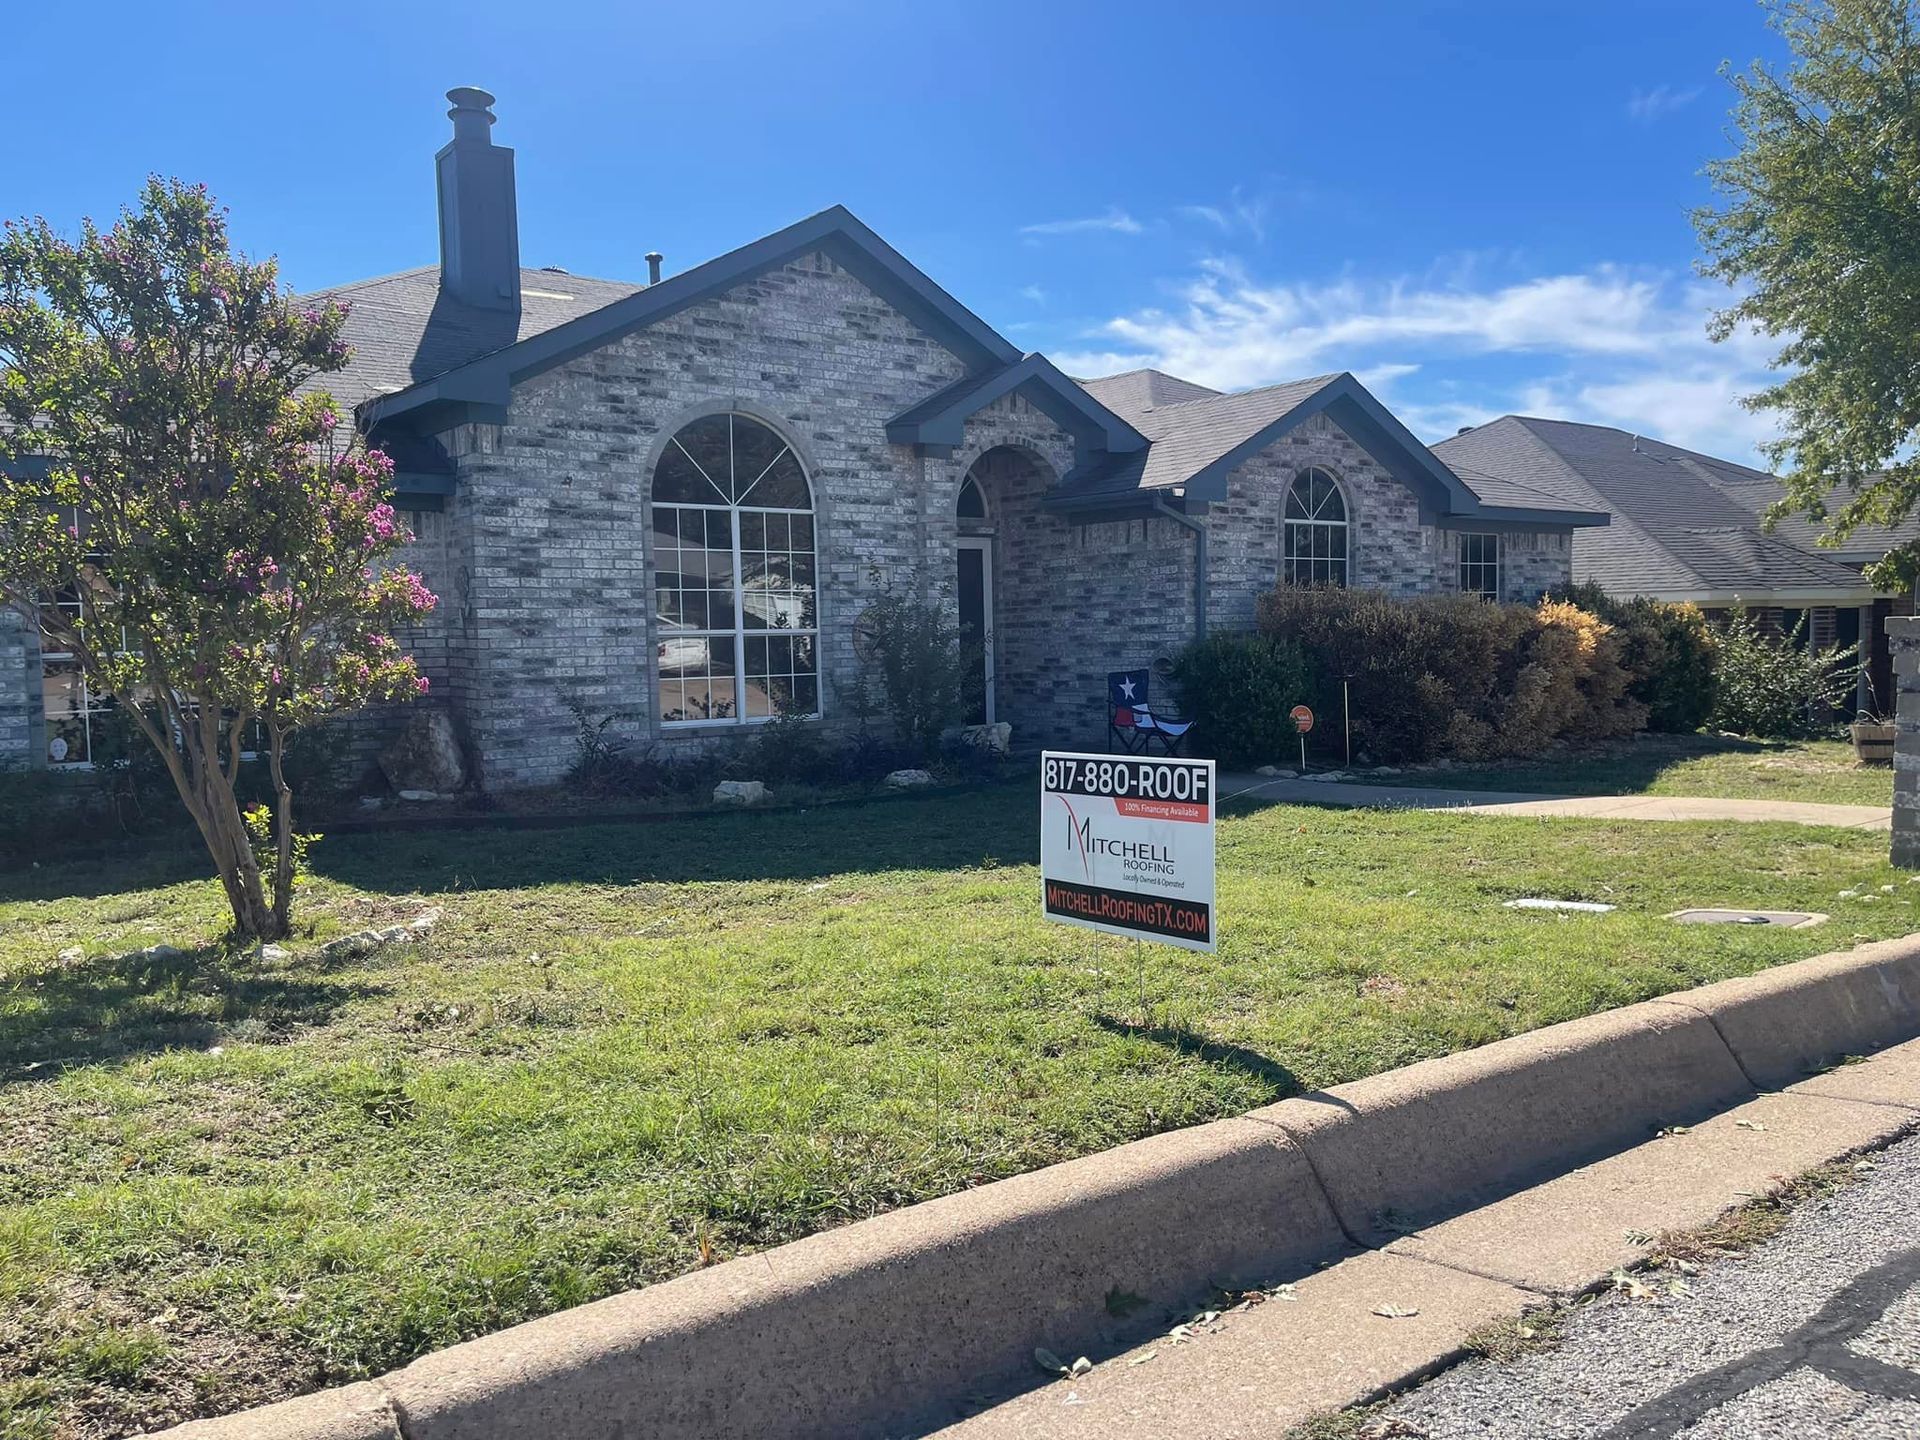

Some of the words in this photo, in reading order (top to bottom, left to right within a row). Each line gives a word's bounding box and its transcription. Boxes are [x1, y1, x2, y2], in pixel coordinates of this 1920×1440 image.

[1046, 759, 1207, 800] 817-880-ROOF
[1124, 802, 1140, 811] 100%
[1141, 803, 1169, 816] Financing
[1170, 805, 1199, 817] Available
[1123, 859, 1175, 875] ROOFING
[1123, 873, 1138, 884] Locally
[1140, 875, 1156, 885] Owned
[1161, 878, 1184, 889] Operated
